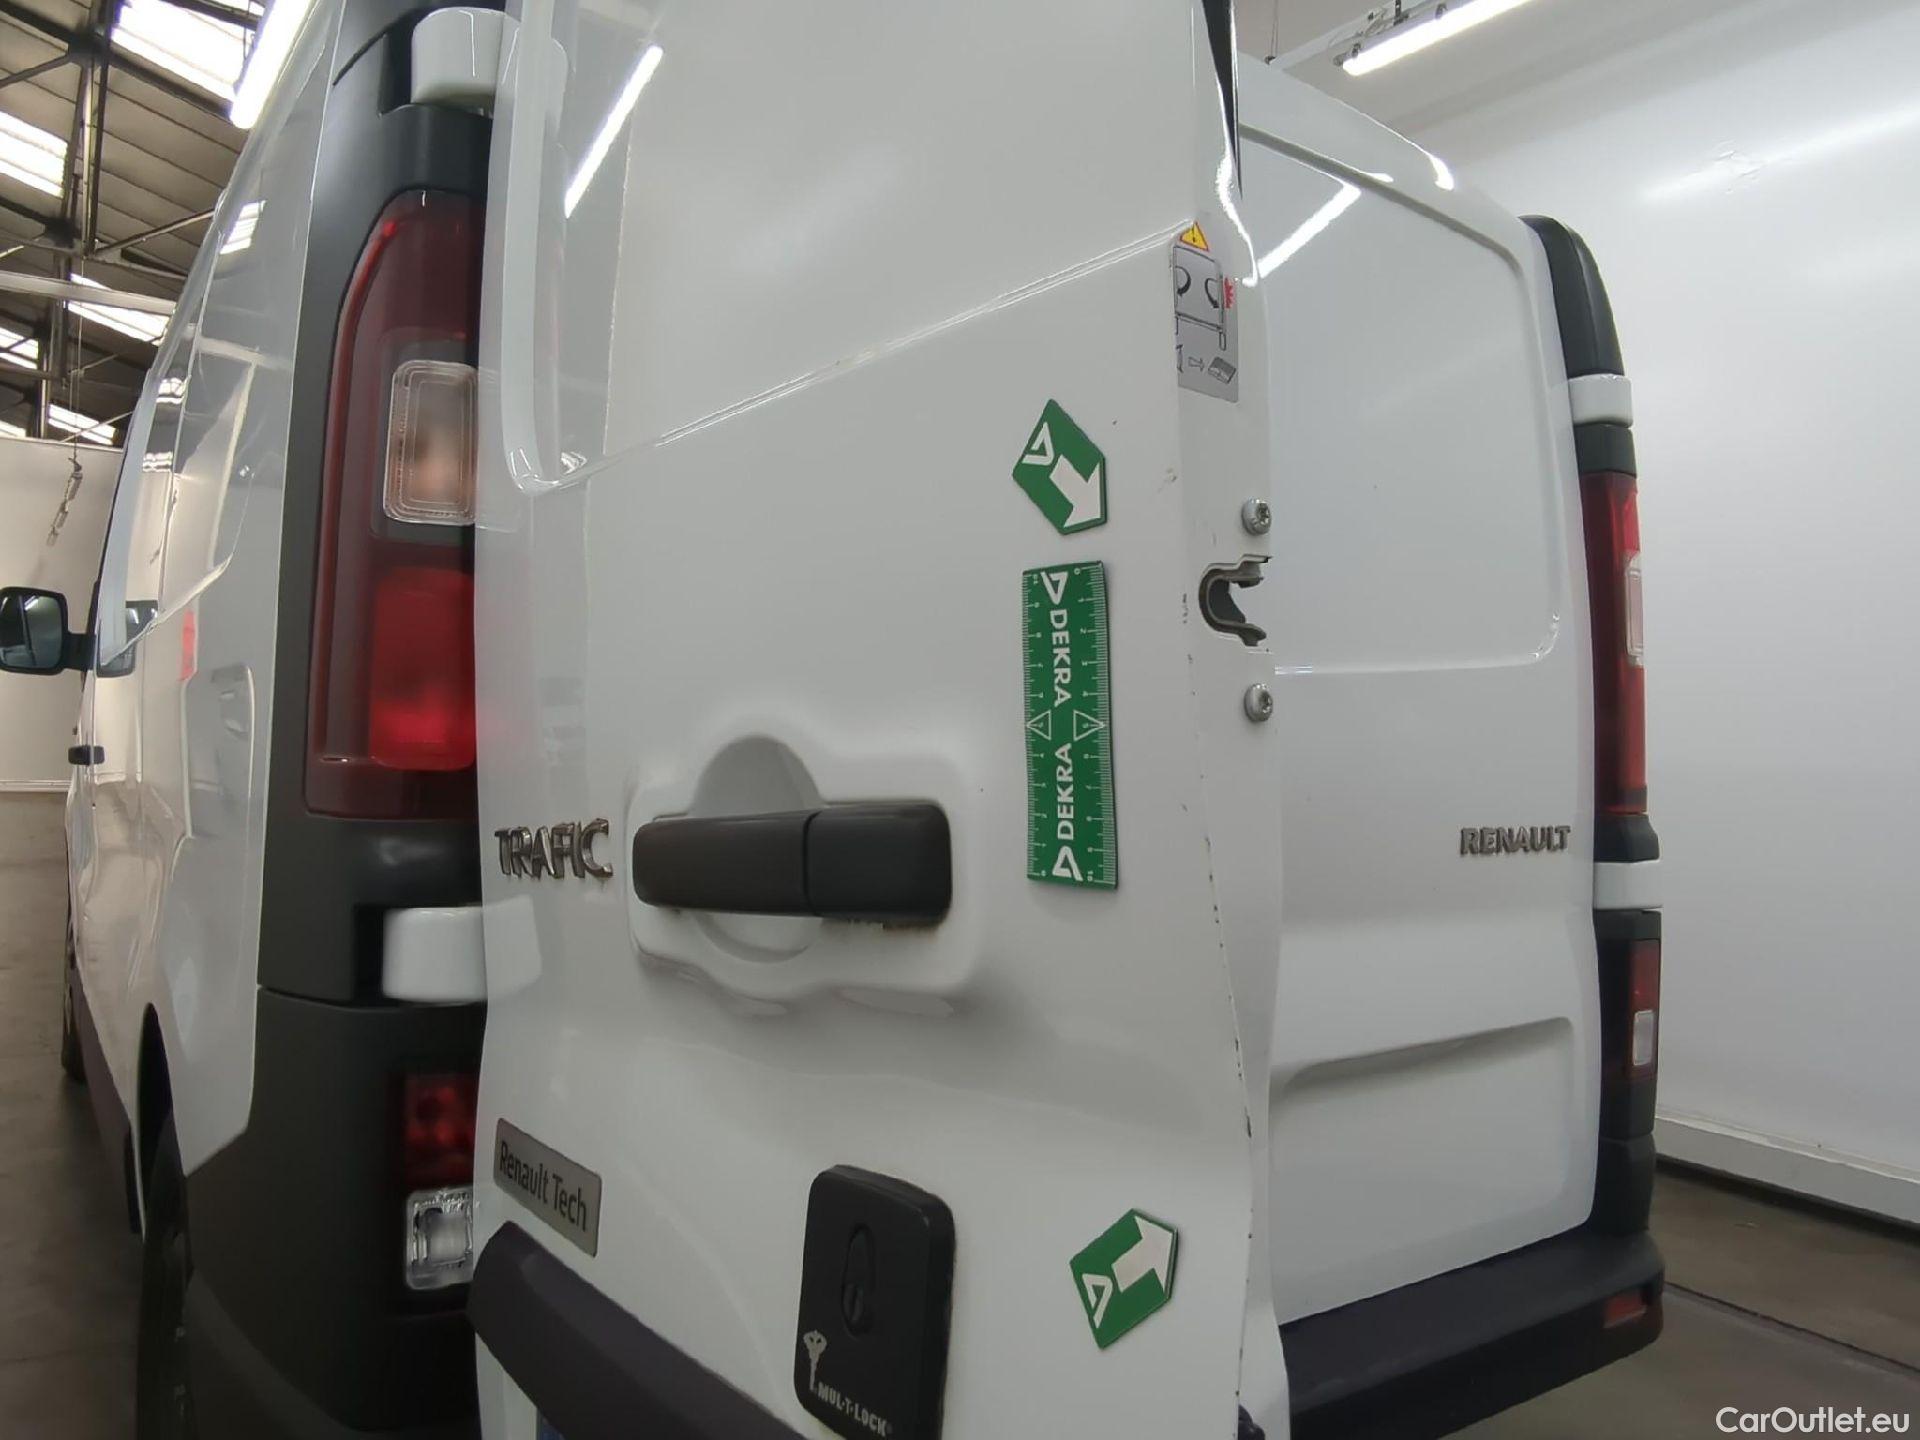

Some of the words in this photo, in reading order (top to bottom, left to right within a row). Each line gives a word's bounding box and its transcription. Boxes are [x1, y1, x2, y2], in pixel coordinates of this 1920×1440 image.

[1050, 608, 1073, 709] DEKRA
[1054, 742, 1075, 841] DEKRA
[494, 818, 613, 879] TRAFIC
[1460, 825, 1571, 856] RENAULT
[500, 1141, 549, 1204] Renault
[552, 1173, 587, 1232] Tech
